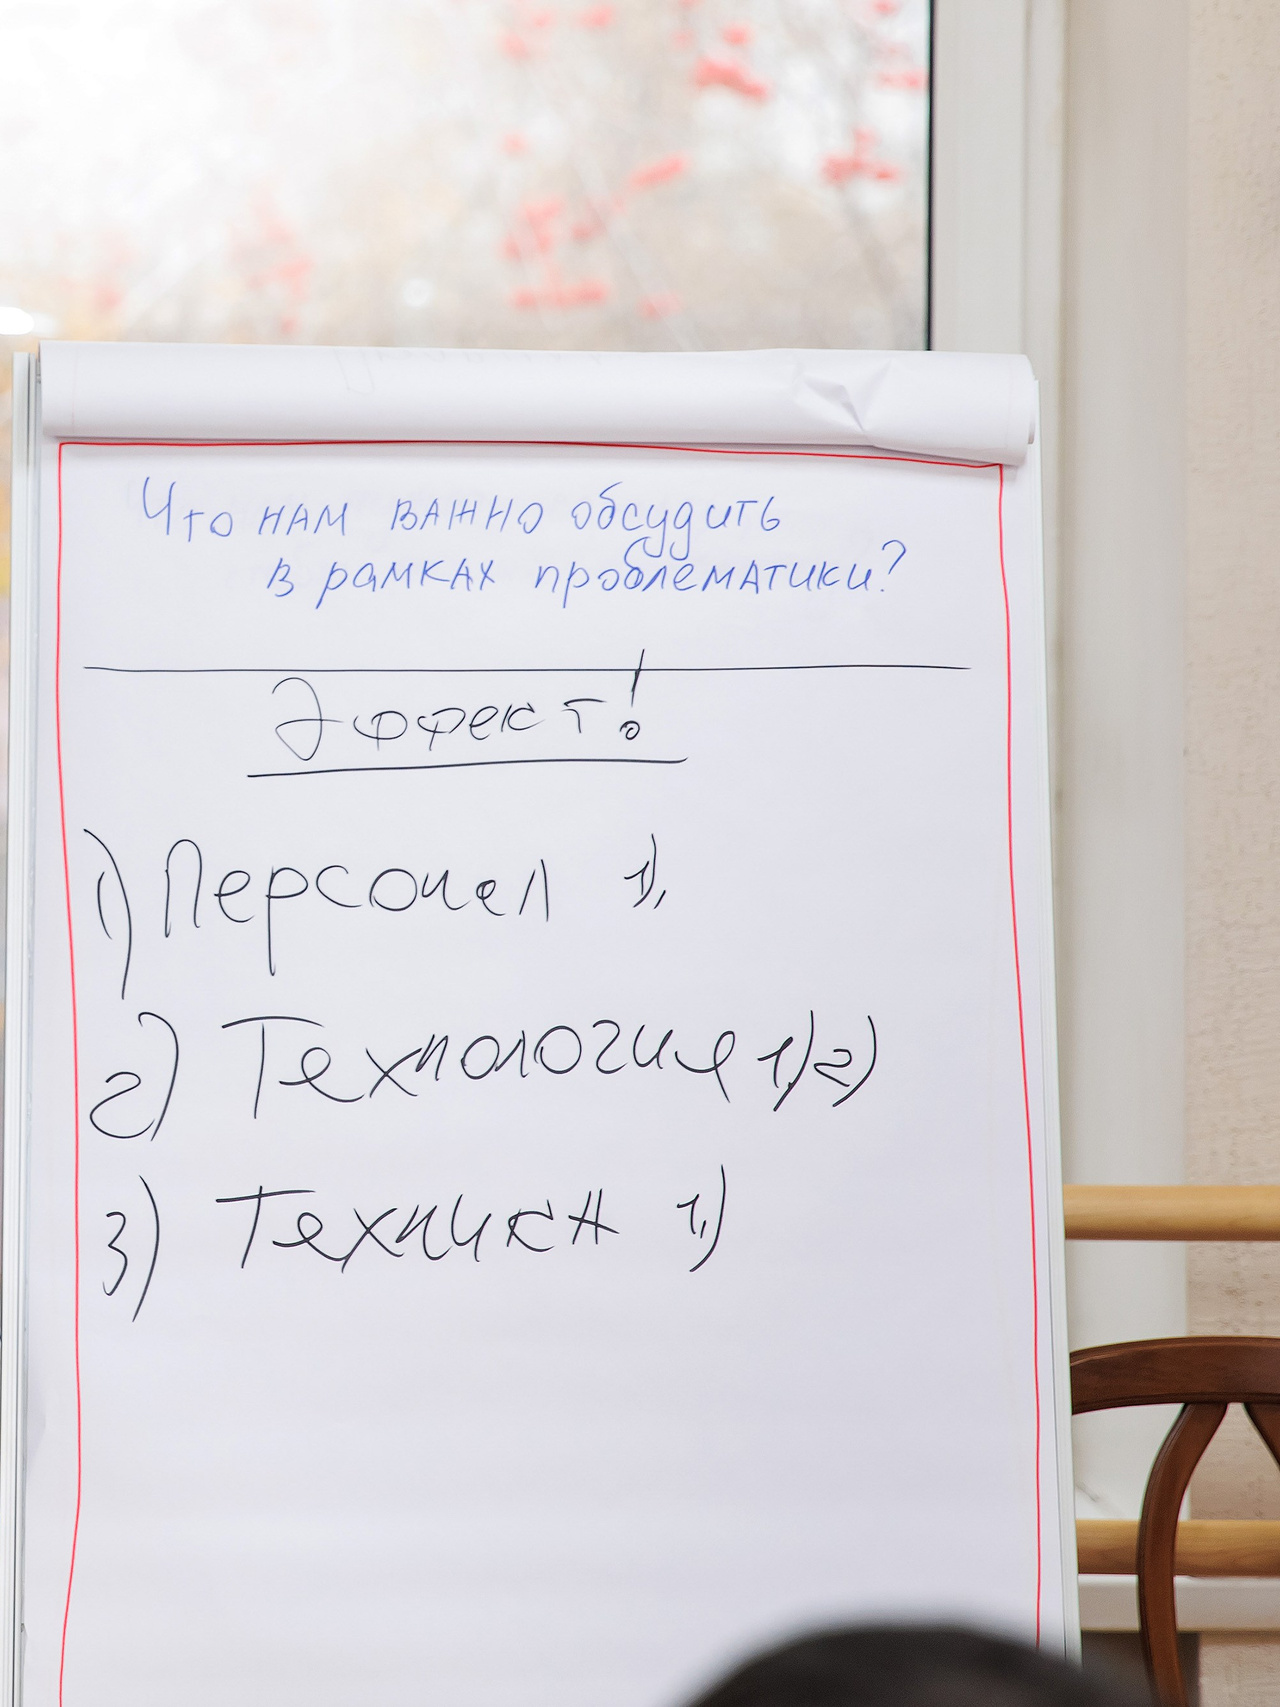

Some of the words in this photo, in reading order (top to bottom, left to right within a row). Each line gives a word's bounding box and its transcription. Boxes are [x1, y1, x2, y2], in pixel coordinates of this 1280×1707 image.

[143, 476, 234, 542] Что
[570, 481, 781, 562] обсудить
[316, 558, 496, 610] рамках
[535, 538, 908, 609] проблематики?
[83, 829, 132, 1000] 1)
[165, 839, 550, 976] Персонал
[89, 1012, 179, 1141] 2)
[103, 1175, 160, 1322] 3)
[215, 1185, 621, 1274] Техника
